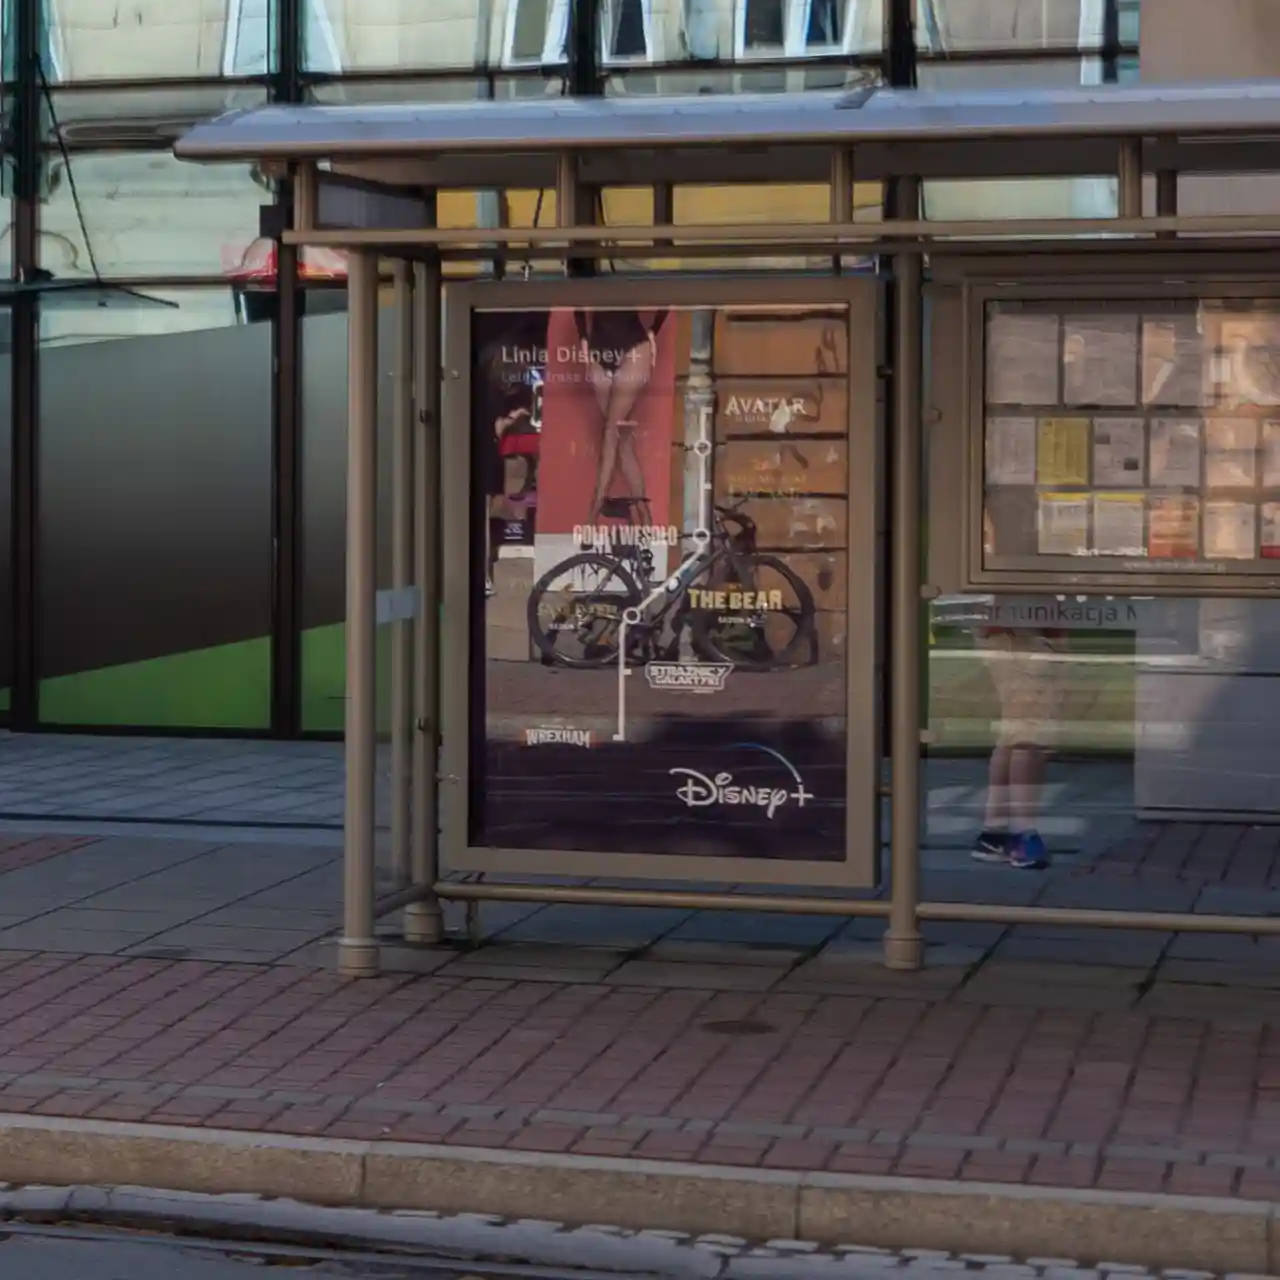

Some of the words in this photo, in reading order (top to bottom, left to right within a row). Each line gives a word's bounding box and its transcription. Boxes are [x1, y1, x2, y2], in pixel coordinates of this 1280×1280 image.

[501, 345, 549, 364] Linia
[724, 395, 807, 416] AVATAR
[687, 588, 726, 610] THE
[729, 589, 783, 610] BEAR
[525, 728, 591, 748] WREXHAM
